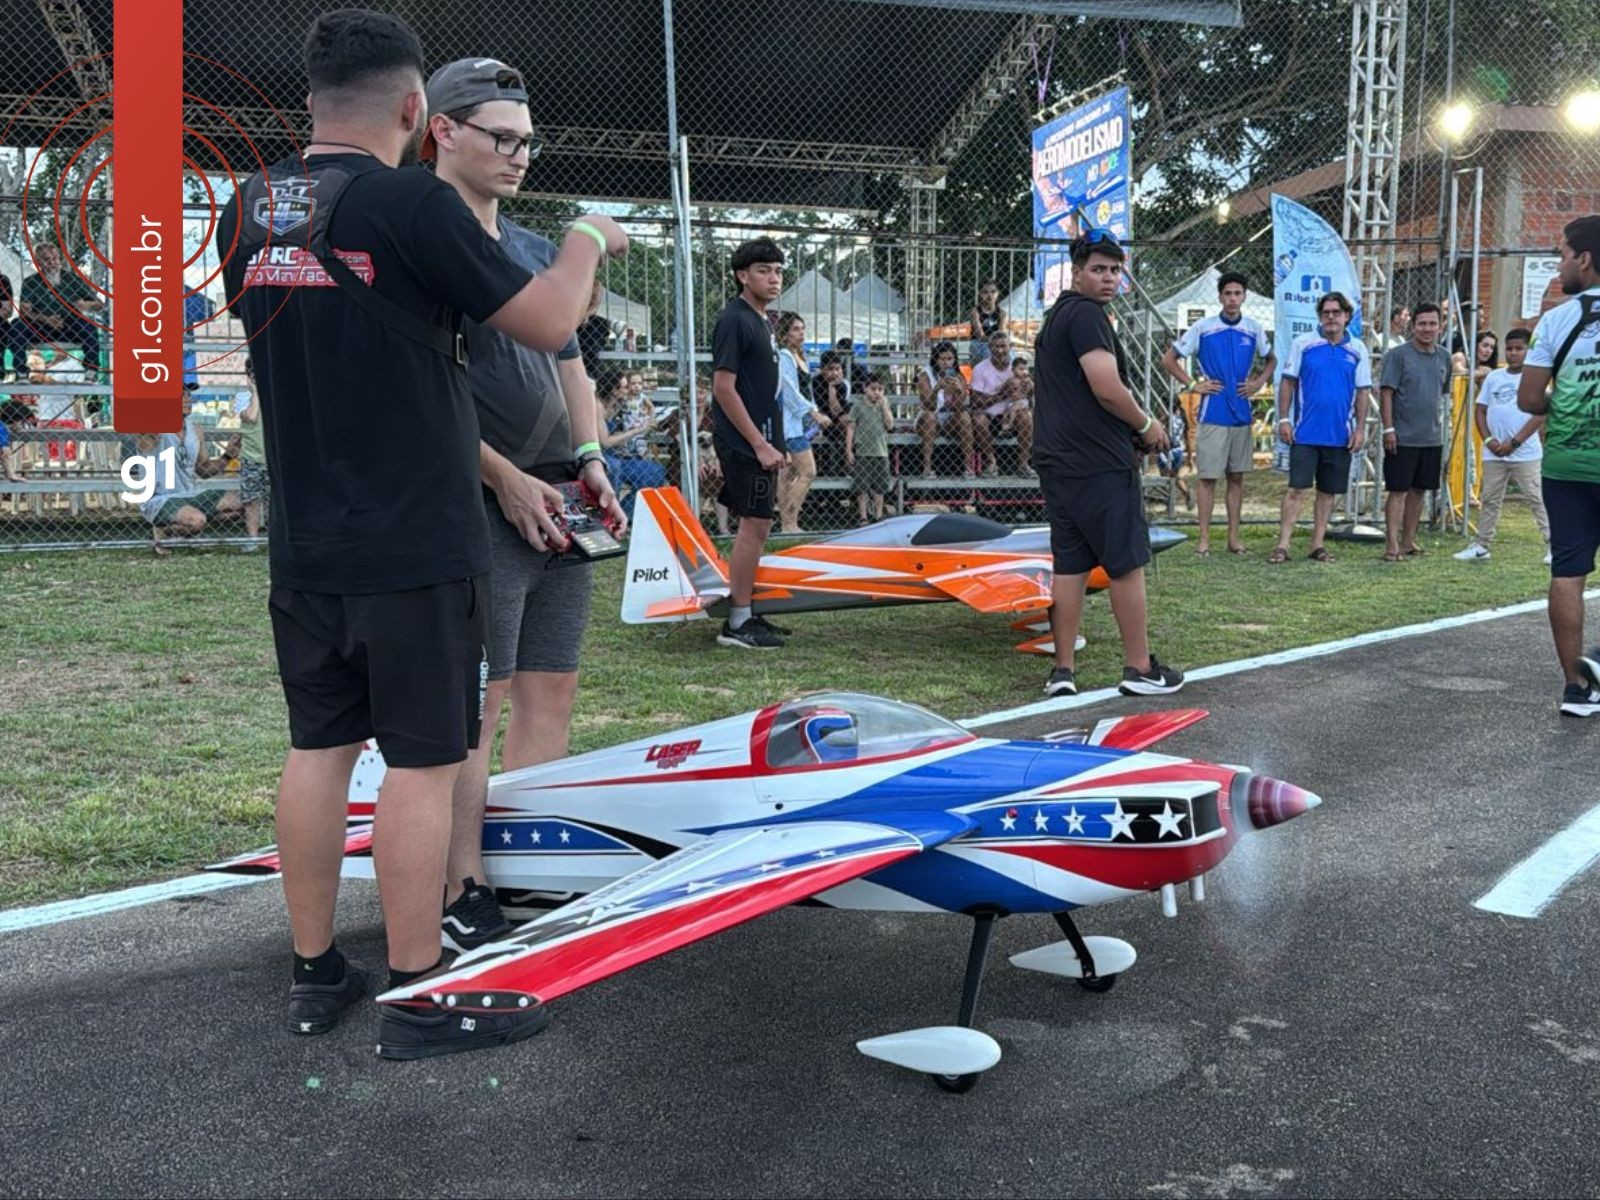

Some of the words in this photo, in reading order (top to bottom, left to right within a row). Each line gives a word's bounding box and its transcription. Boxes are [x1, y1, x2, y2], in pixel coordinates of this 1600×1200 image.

[1038, 116, 1123, 178] AEROMODELISMO
[632, 567, 670, 583] Pilot
[480, 661, 489, 688] PRO
